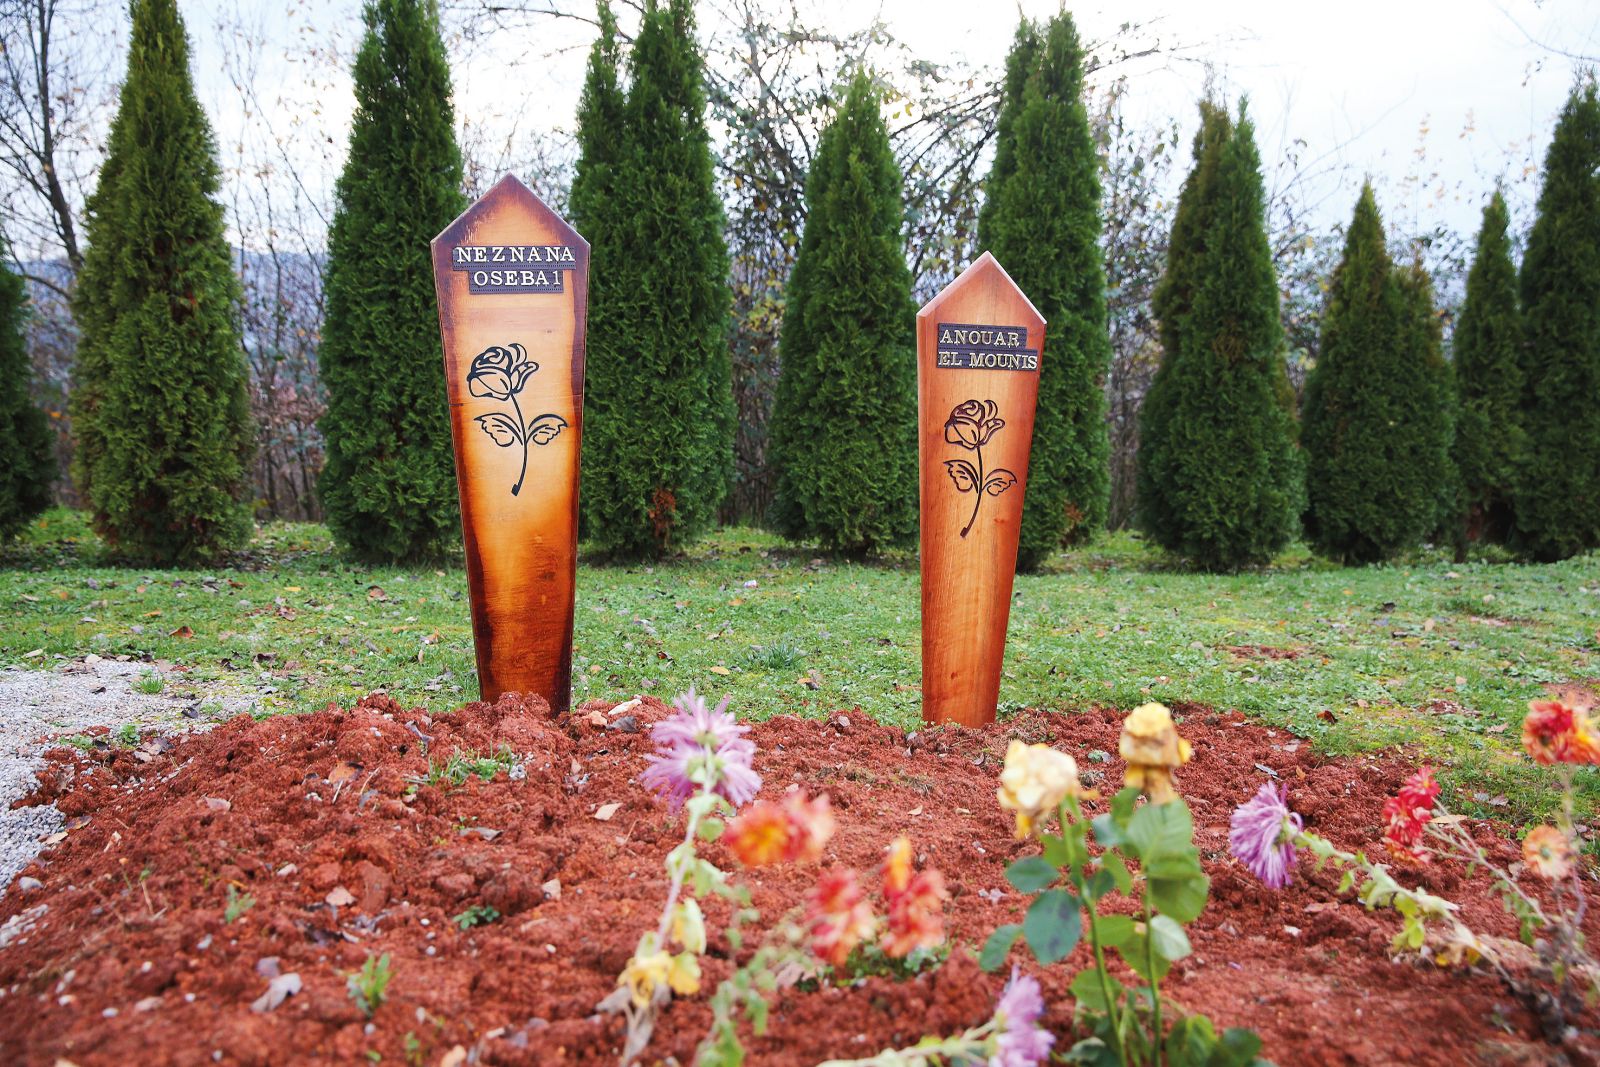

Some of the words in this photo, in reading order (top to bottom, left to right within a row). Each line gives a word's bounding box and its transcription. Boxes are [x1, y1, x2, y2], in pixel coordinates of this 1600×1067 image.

[457, 247, 575, 263] NEZNANA
[939, 329, 1020, 347] ANOUAR
[938, 351, 962, 366] EL
[968, 352, 1038, 369] MOUNIS
